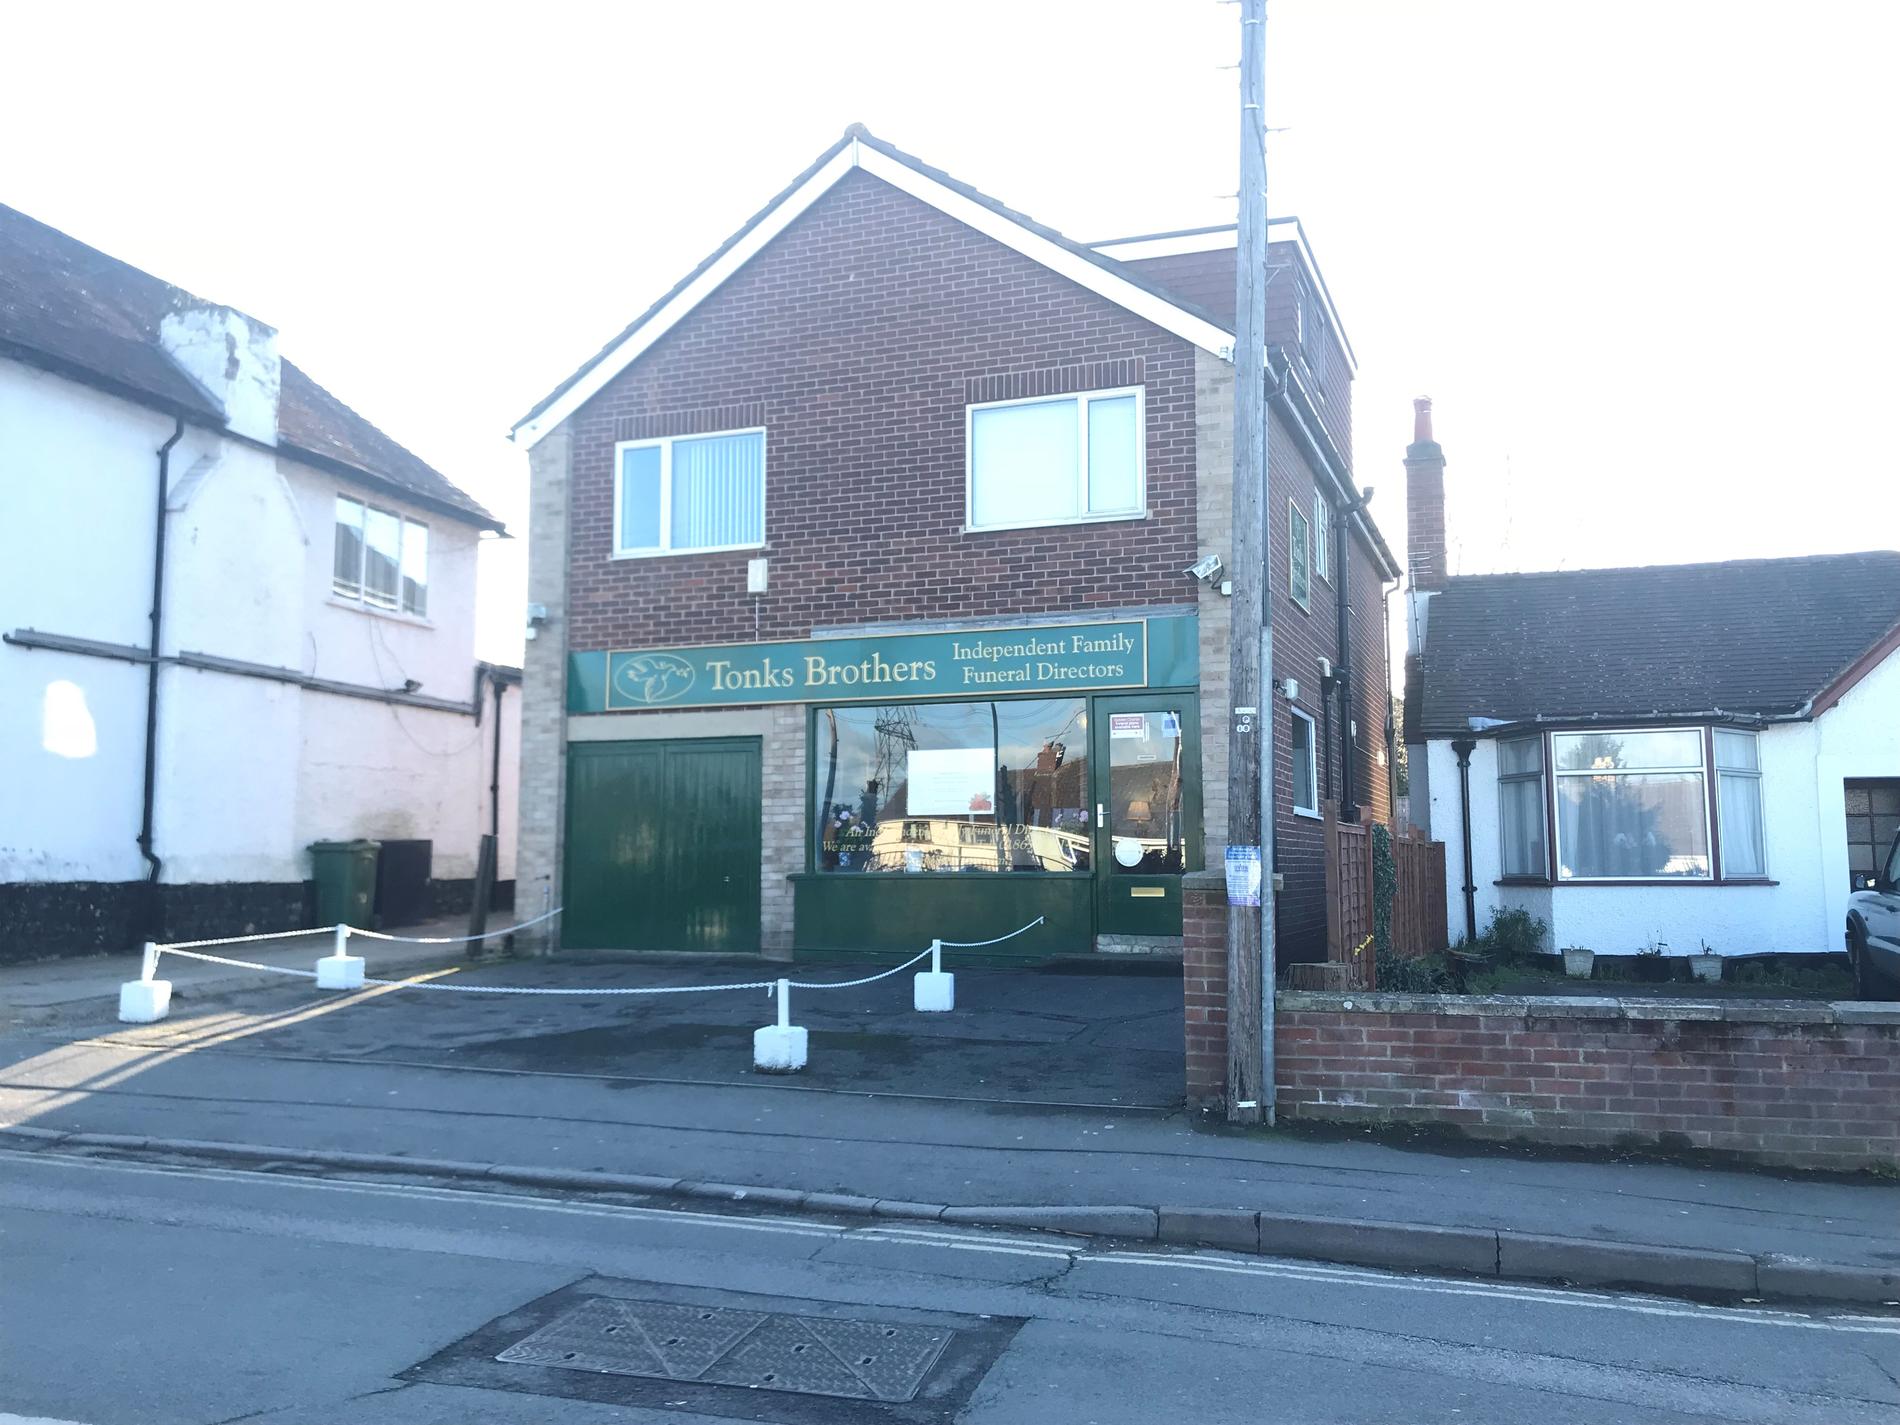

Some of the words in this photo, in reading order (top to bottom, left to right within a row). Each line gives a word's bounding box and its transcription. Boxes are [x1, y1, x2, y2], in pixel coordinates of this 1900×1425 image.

[952, 638, 1066, 662] Independent
[1072, 632, 1135, 655] Family
[706, 657, 794, 691] Tonks
[803, 651, 937, 687] Brothers
[963, 663, 1031, 684] Funeral
[1037, 662, 1124, 681] Directors
[823, 841, 839, 852] We
